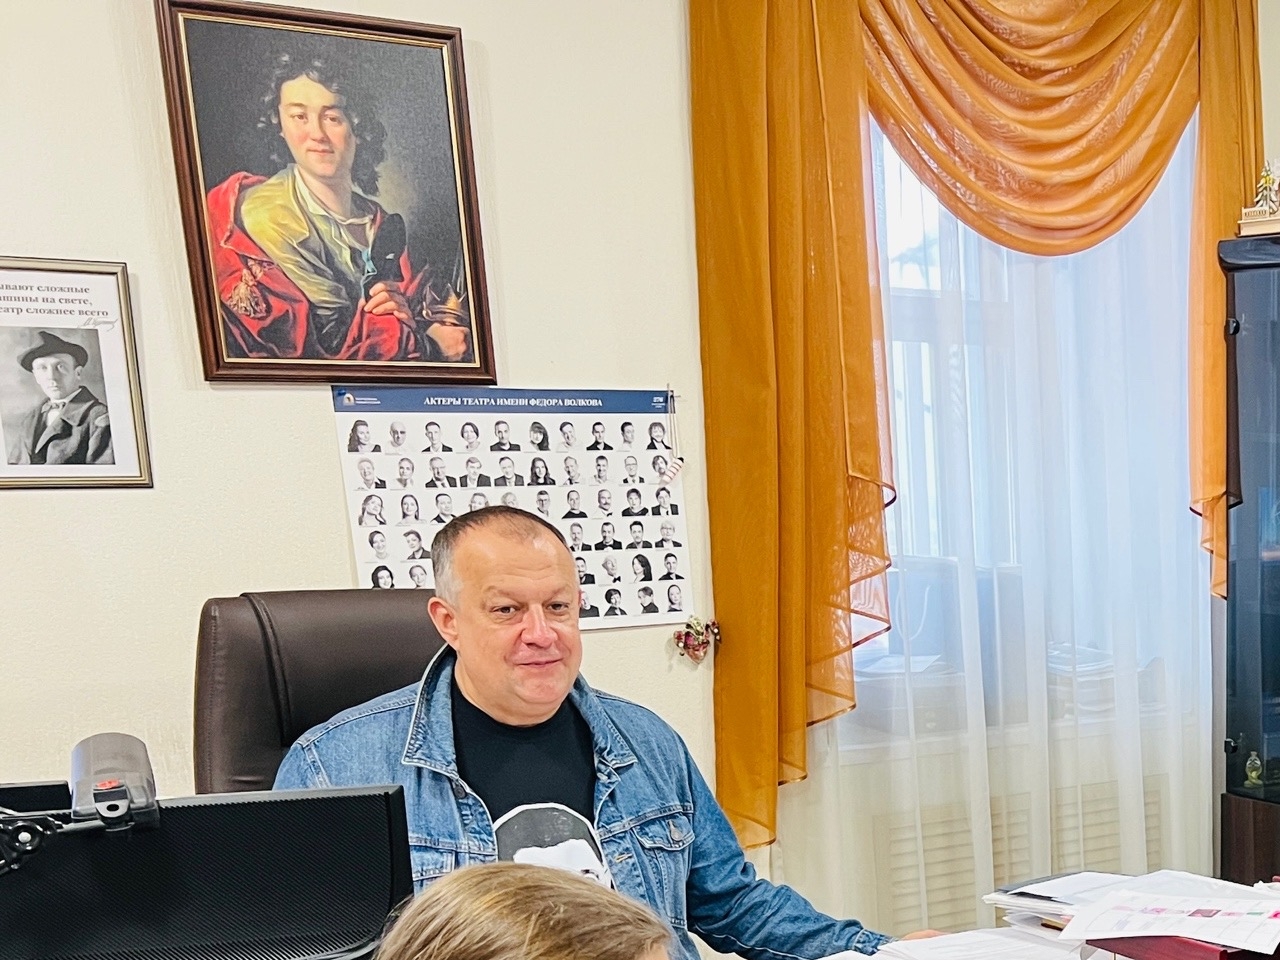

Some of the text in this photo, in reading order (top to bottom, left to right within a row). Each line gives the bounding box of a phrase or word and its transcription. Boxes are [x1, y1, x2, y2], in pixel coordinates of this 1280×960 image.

[37, 285, 90, 294] сложные
[0, 295, 39, 303] шины
[58, 298, 93, 306] свете,
[26, 307, 75, 316] сложнее
[423, 396, 603, 407] АКТЕРЫ ТЕАТРА ИМЕНИ ФЕДОРА ВОЛКОВА
